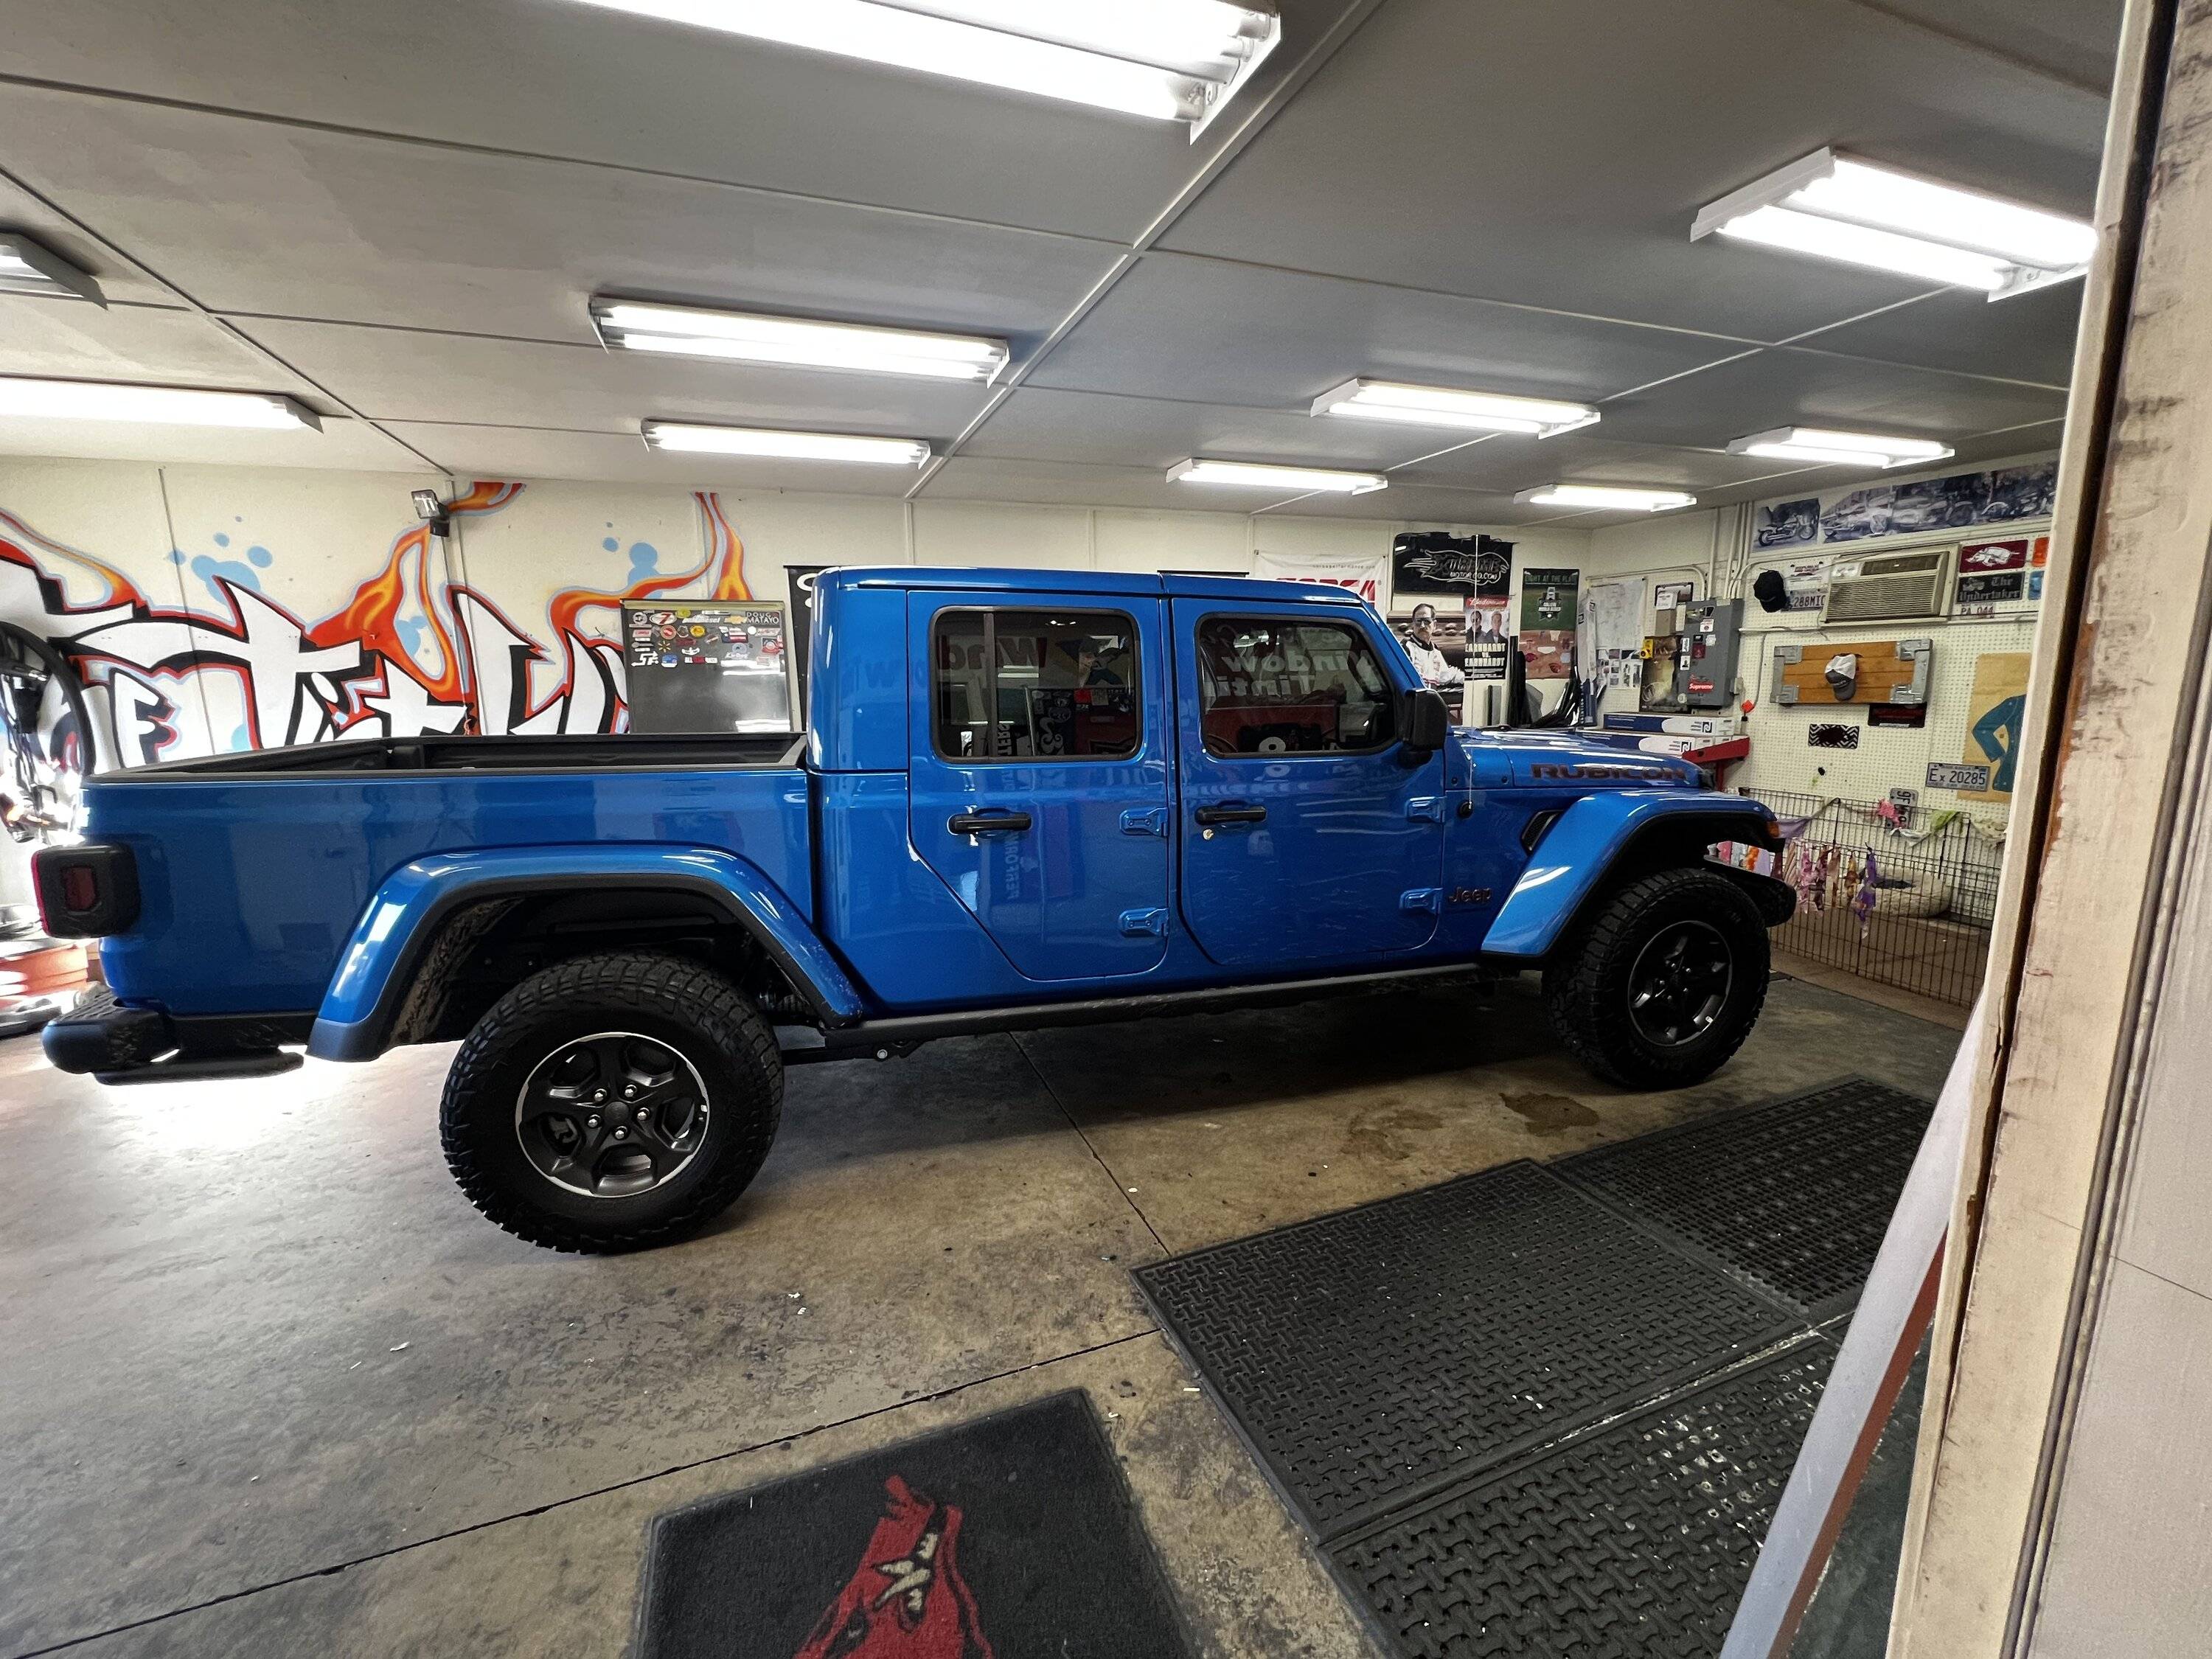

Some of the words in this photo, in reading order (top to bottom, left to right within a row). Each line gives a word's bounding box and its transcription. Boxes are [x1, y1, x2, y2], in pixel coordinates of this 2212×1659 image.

[1991, 575, 2013, 587] The
[1688, 683, 1714, 691] Supreme
[1531, 763, 1688, 780] RUBICON
[1950, 771, 1986, 785] 20285
[1449, 886, 1491, 903] Jeep
